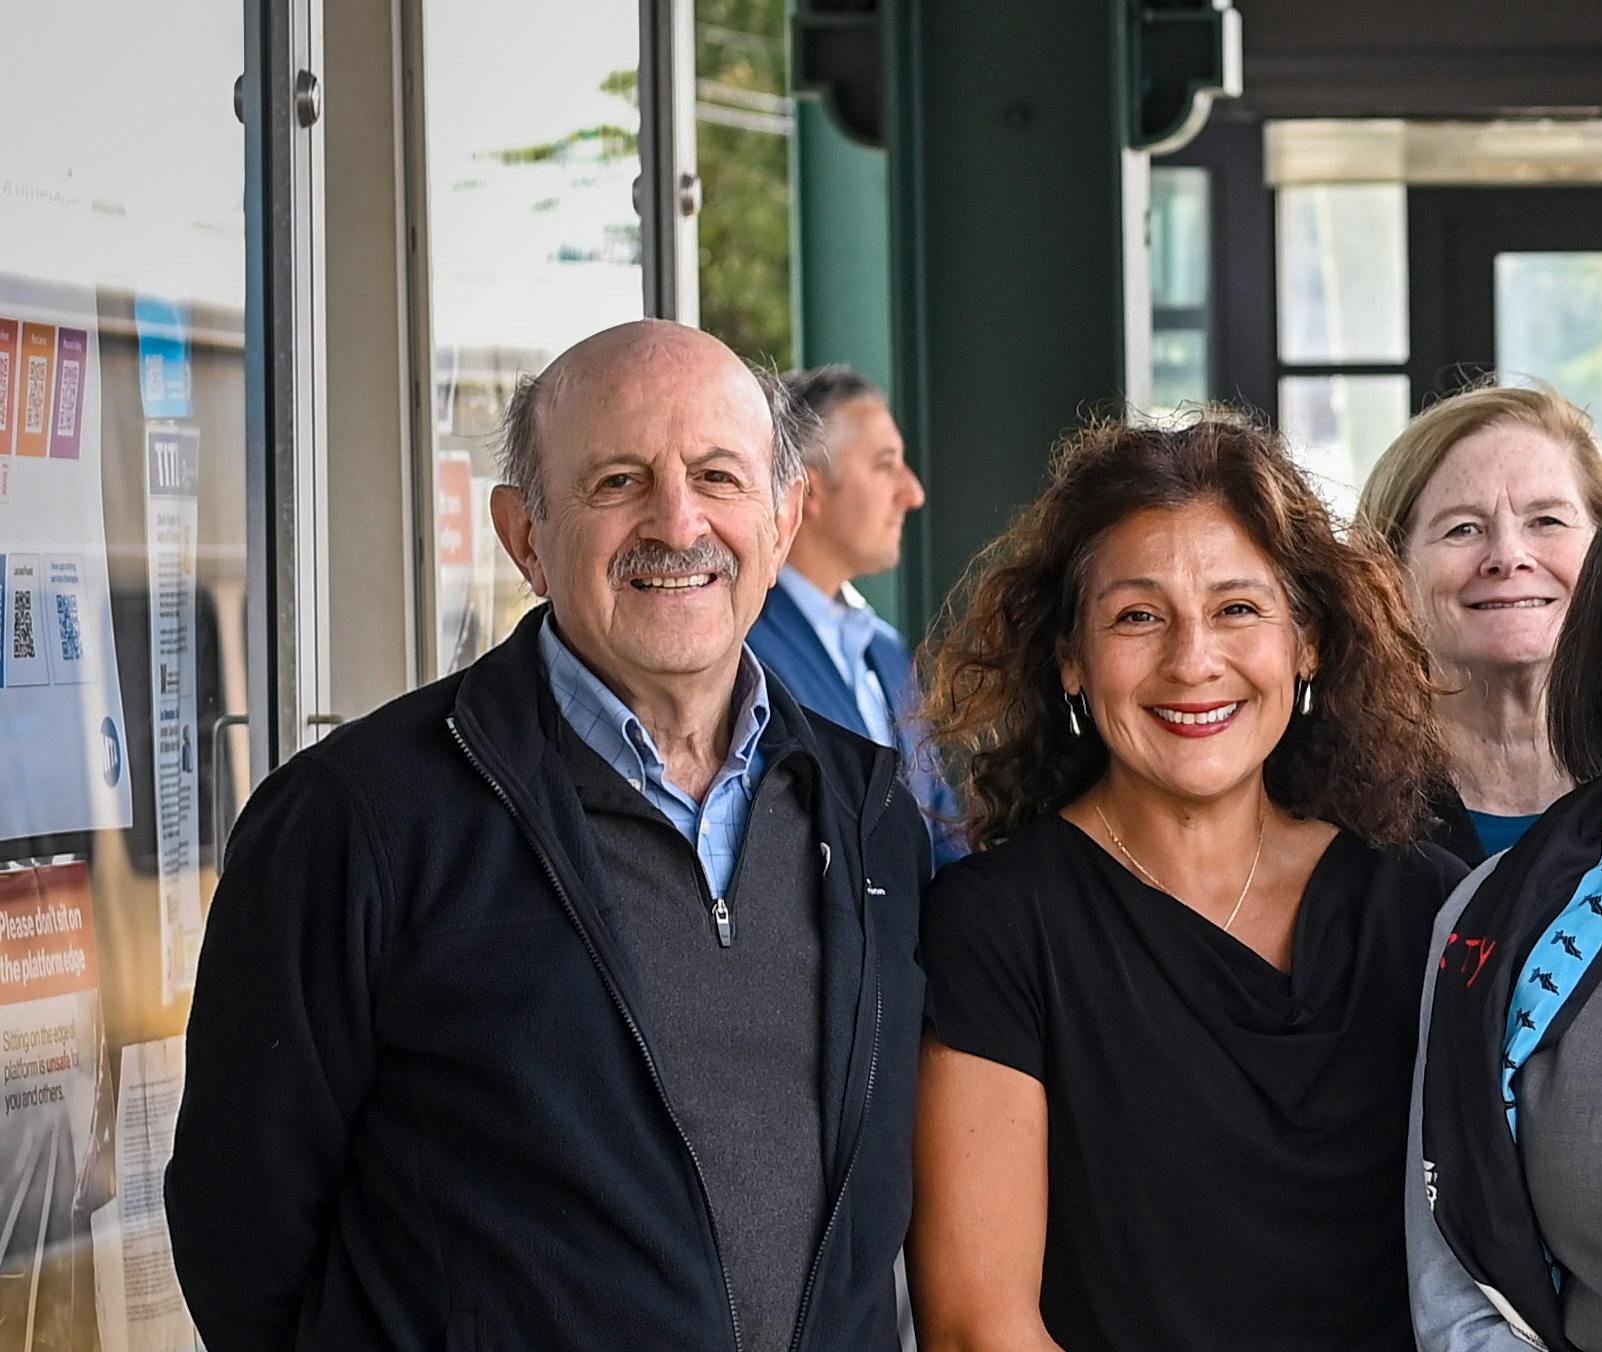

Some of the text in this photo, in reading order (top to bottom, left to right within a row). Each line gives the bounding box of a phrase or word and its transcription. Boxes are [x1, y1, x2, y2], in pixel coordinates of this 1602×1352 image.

[0, 910, 35, 940] Please
[35, 904, 57, 935] don't
[69, 908, 83, 931] on
[0, 953, 21, 983] the
[21, 947, 63, 987] platform
[3, 1029, 30, 1053] Sitting
[30, 1031, 41, 1047] on
[4, 1055, 38, 1086] platform
[39, 1054, 46, 1075] is
[47, 1050, 71, 1074] unsafe
[4, 1092, 21, 1116] you
[22, 1084, 38, 1108] and
